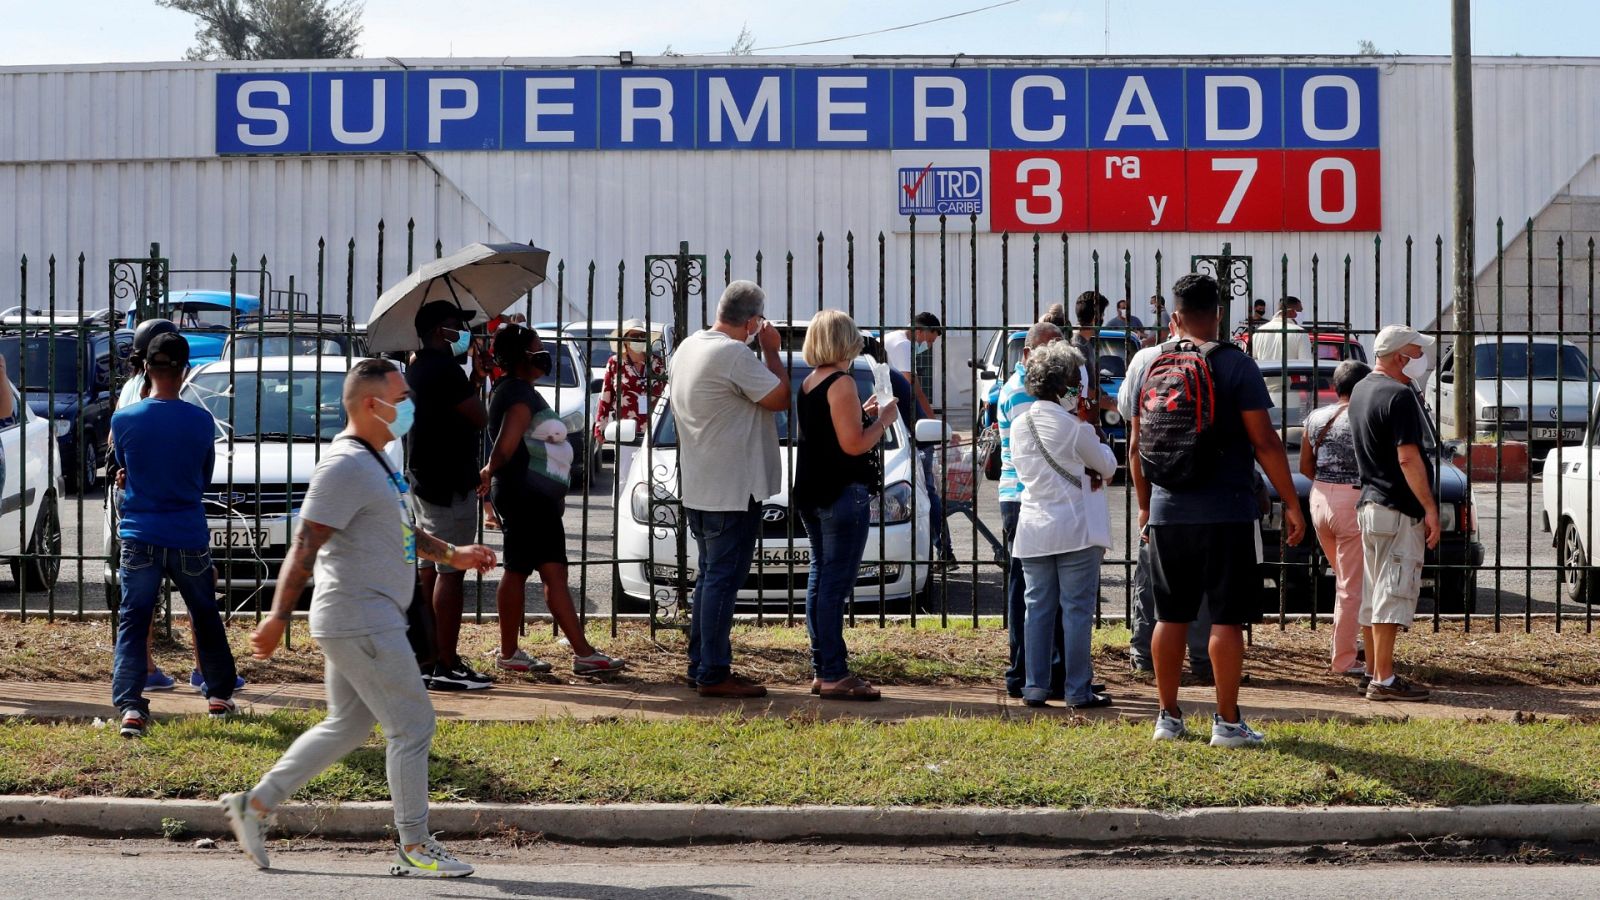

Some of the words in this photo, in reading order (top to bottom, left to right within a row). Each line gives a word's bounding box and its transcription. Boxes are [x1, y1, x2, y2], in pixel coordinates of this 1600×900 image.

[237, 75, 1361, 146] SUPERMERCADO
[936, 170, 980, 198] TRD
[937, 201, 981, 213] CARIBE
[1149, 196, 1168, 226] y
